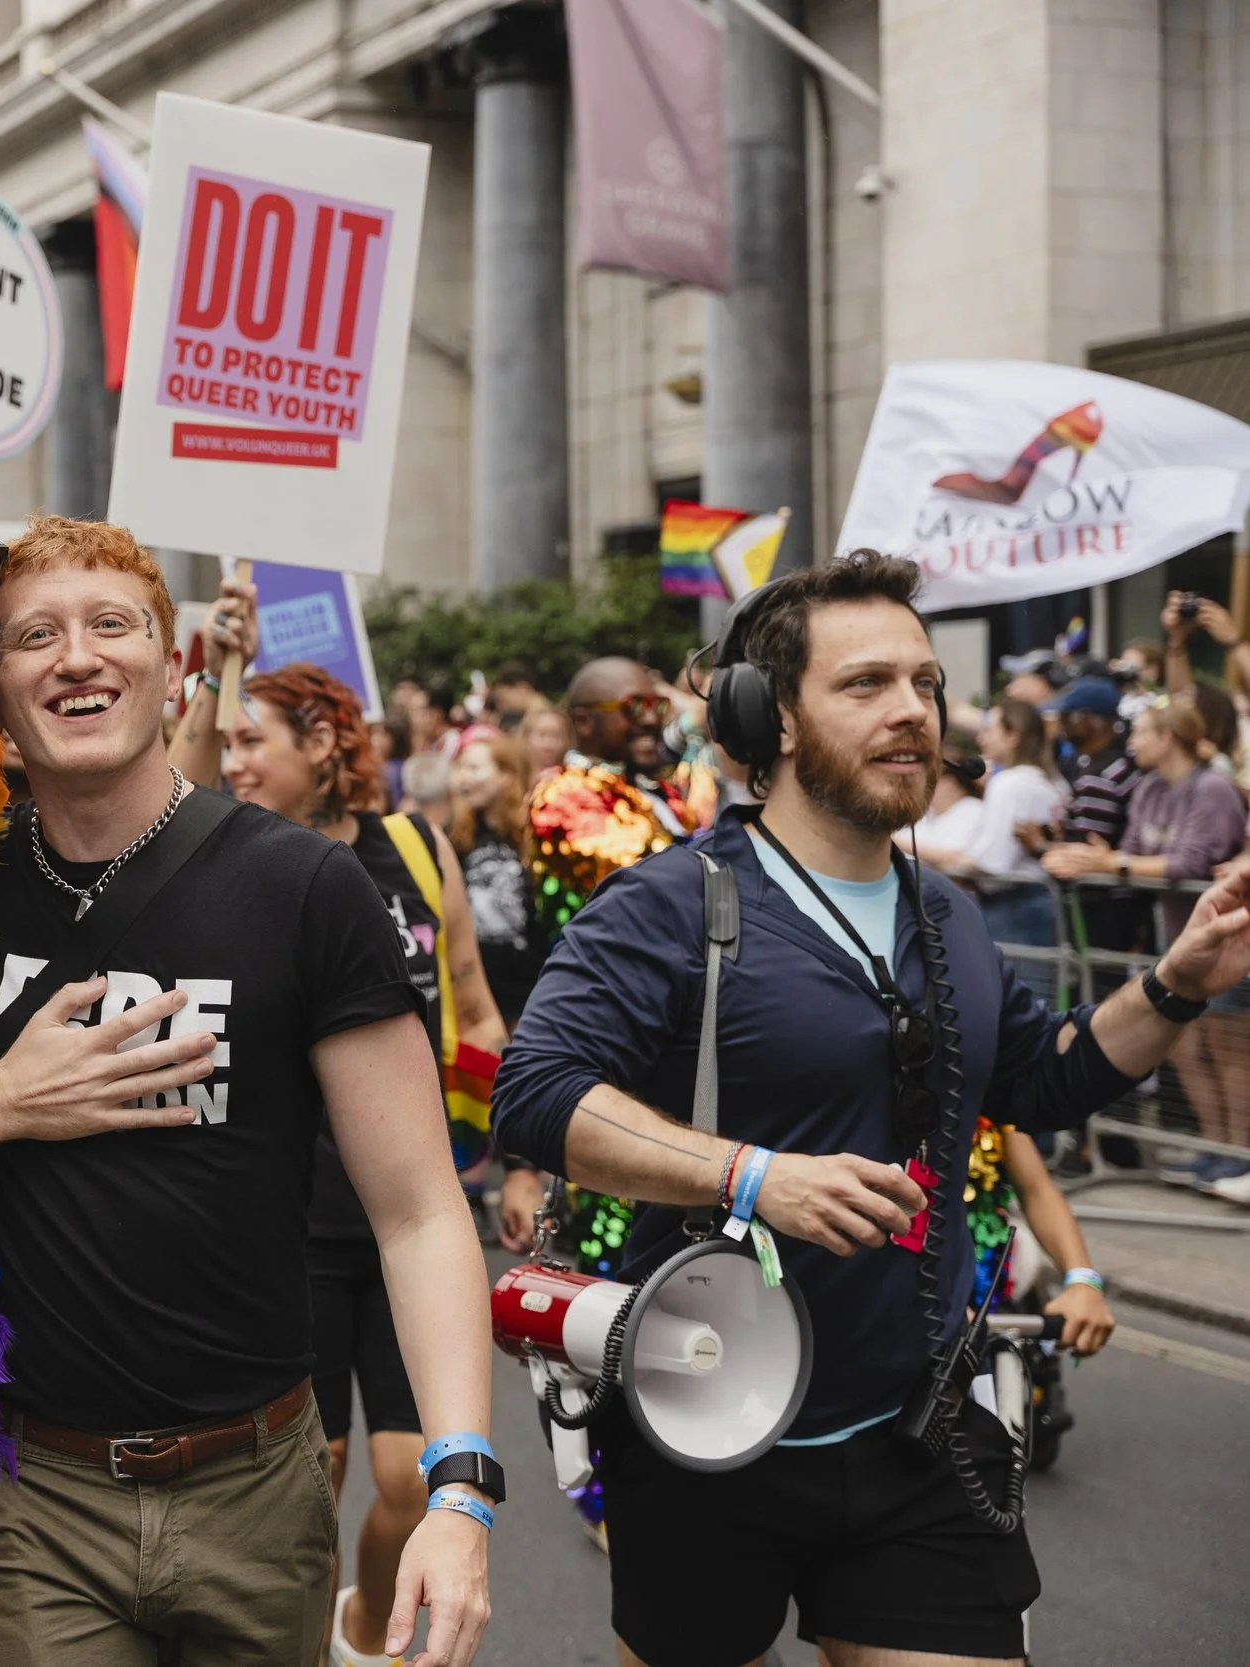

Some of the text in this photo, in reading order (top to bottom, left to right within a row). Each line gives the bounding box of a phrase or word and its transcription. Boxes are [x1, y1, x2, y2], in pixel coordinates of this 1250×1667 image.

[177, 177, 384, 361] DO IT
[173, 337, 363, 398] TO PROTECT
[166, 371, 357, 432] QUEER YOUTH
[916, 521, 1135, 580] OUTURE
